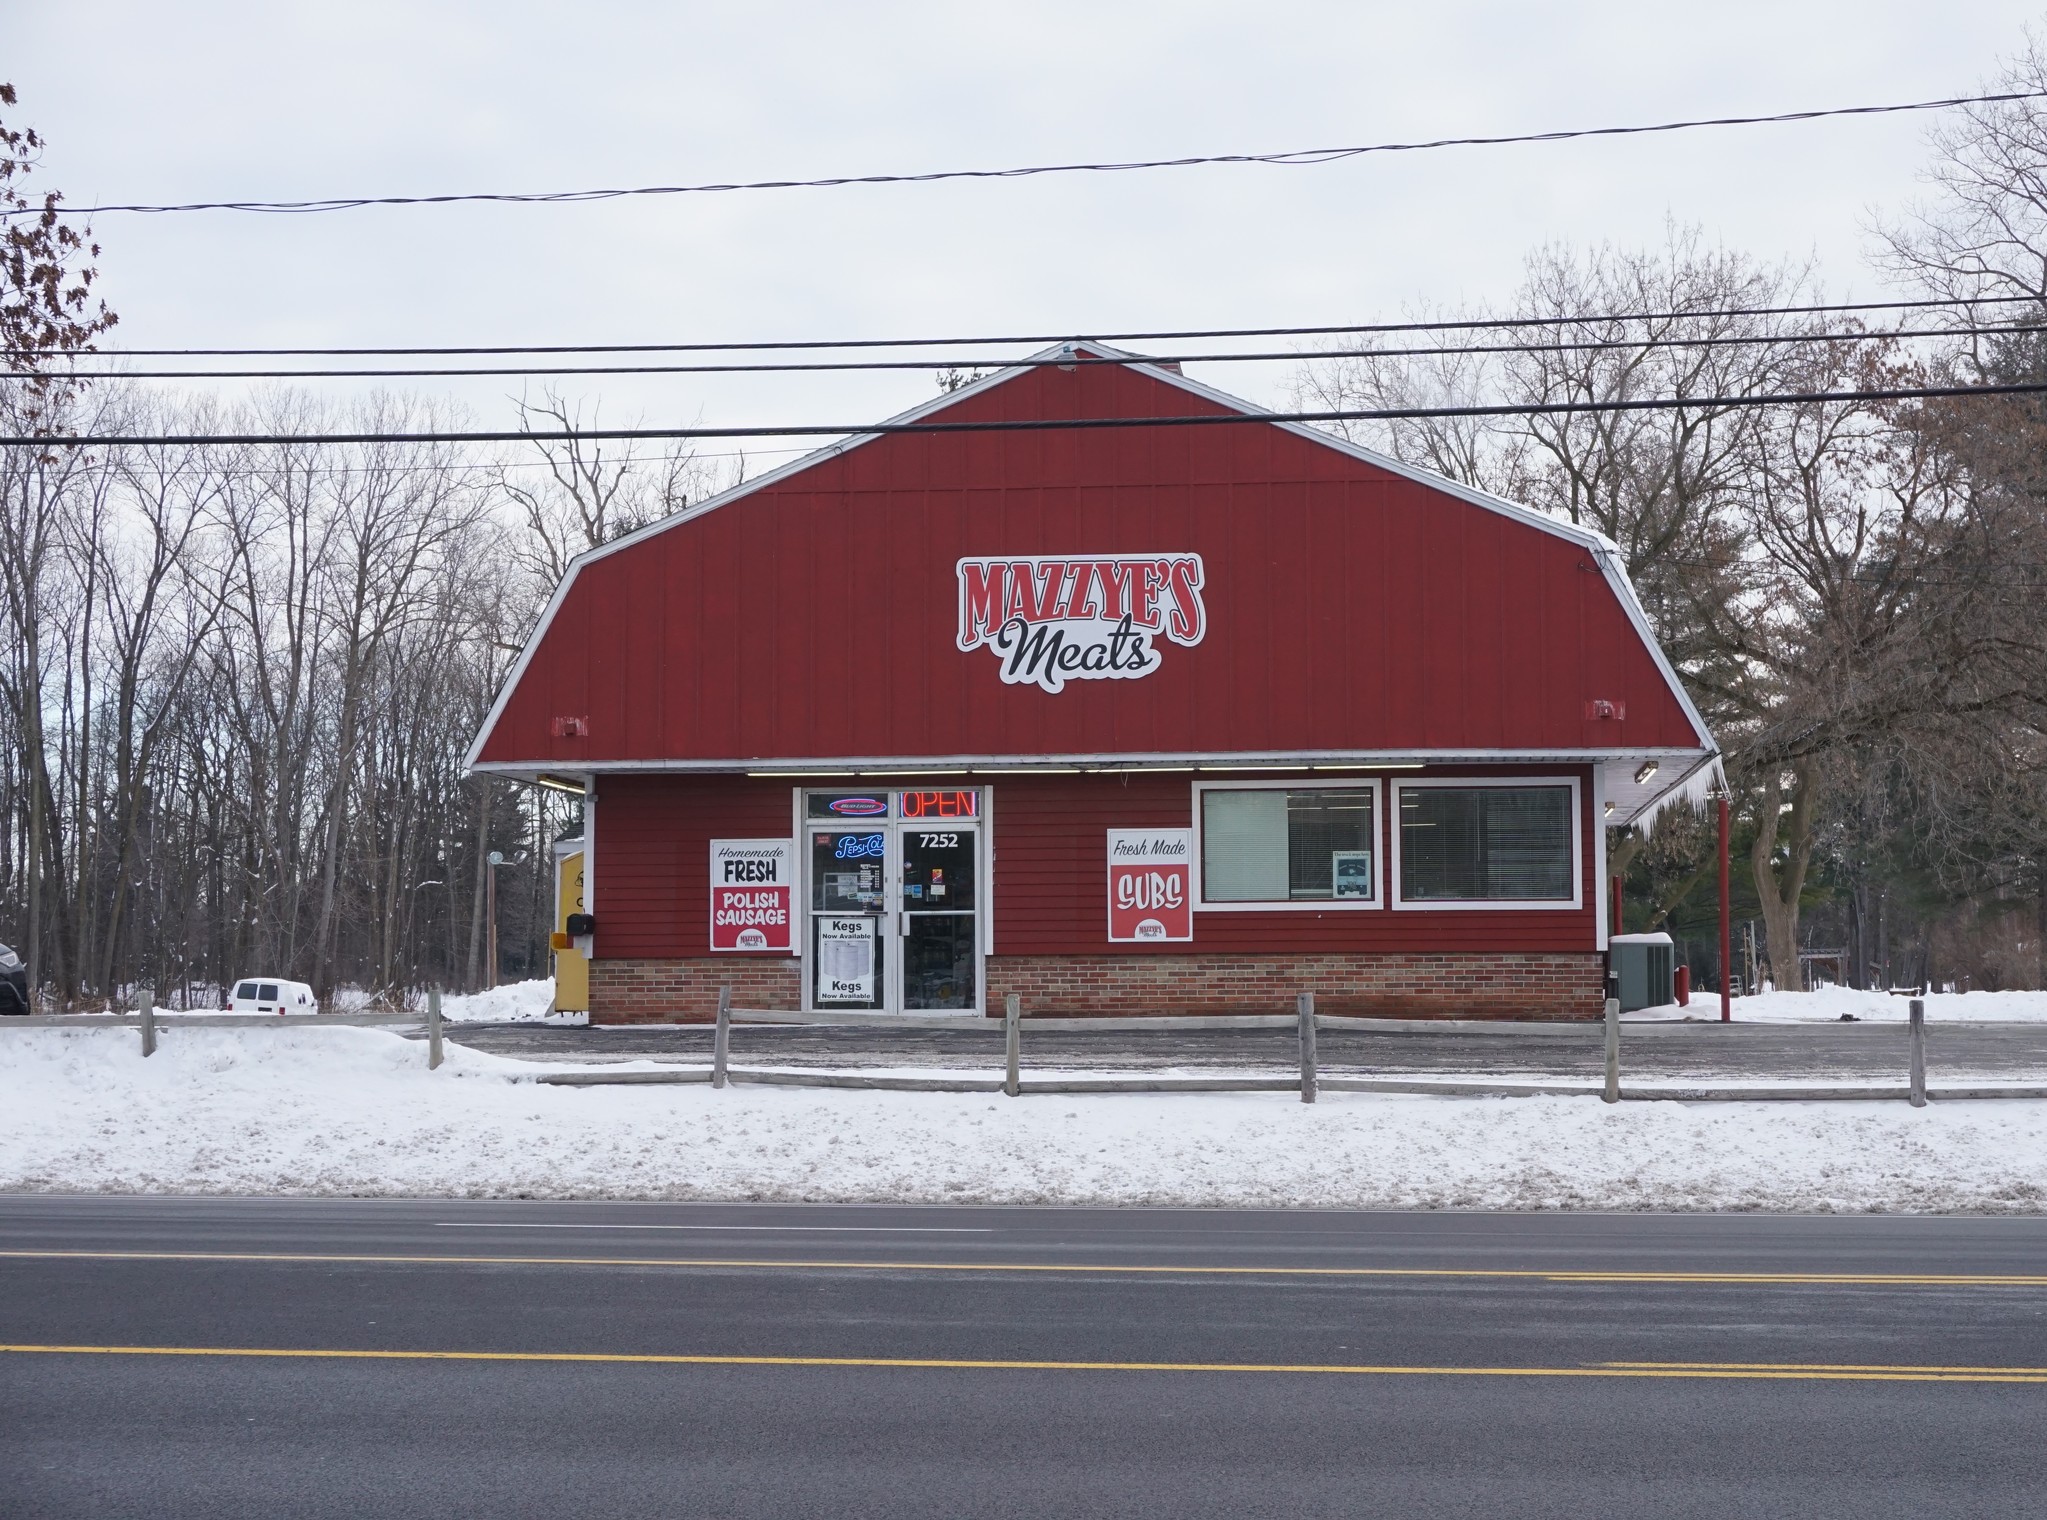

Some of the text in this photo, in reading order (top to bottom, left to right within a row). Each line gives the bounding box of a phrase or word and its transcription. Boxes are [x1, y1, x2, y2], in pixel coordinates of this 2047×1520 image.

[962, 558, 1200, 645] MAZZYE'S
[997, 612, 1153, 685] Meats
[903, 792, 973, 817] OPEN
[919, 833, 958, 848] 7252
[1113, 839, 1186, 856] Fresh Made
[718, 847, 784, 858] Homemade
[724, 858, 777, 882] FRESH
[1117, 872, 1183, 910] SUBS
[723, 891, 779, 909] POLISH
[716, 909, 786, 926] SAUSAGE
[832, 920, 862, 933] Kegs
[832, 980, 862, 993] Kegs
